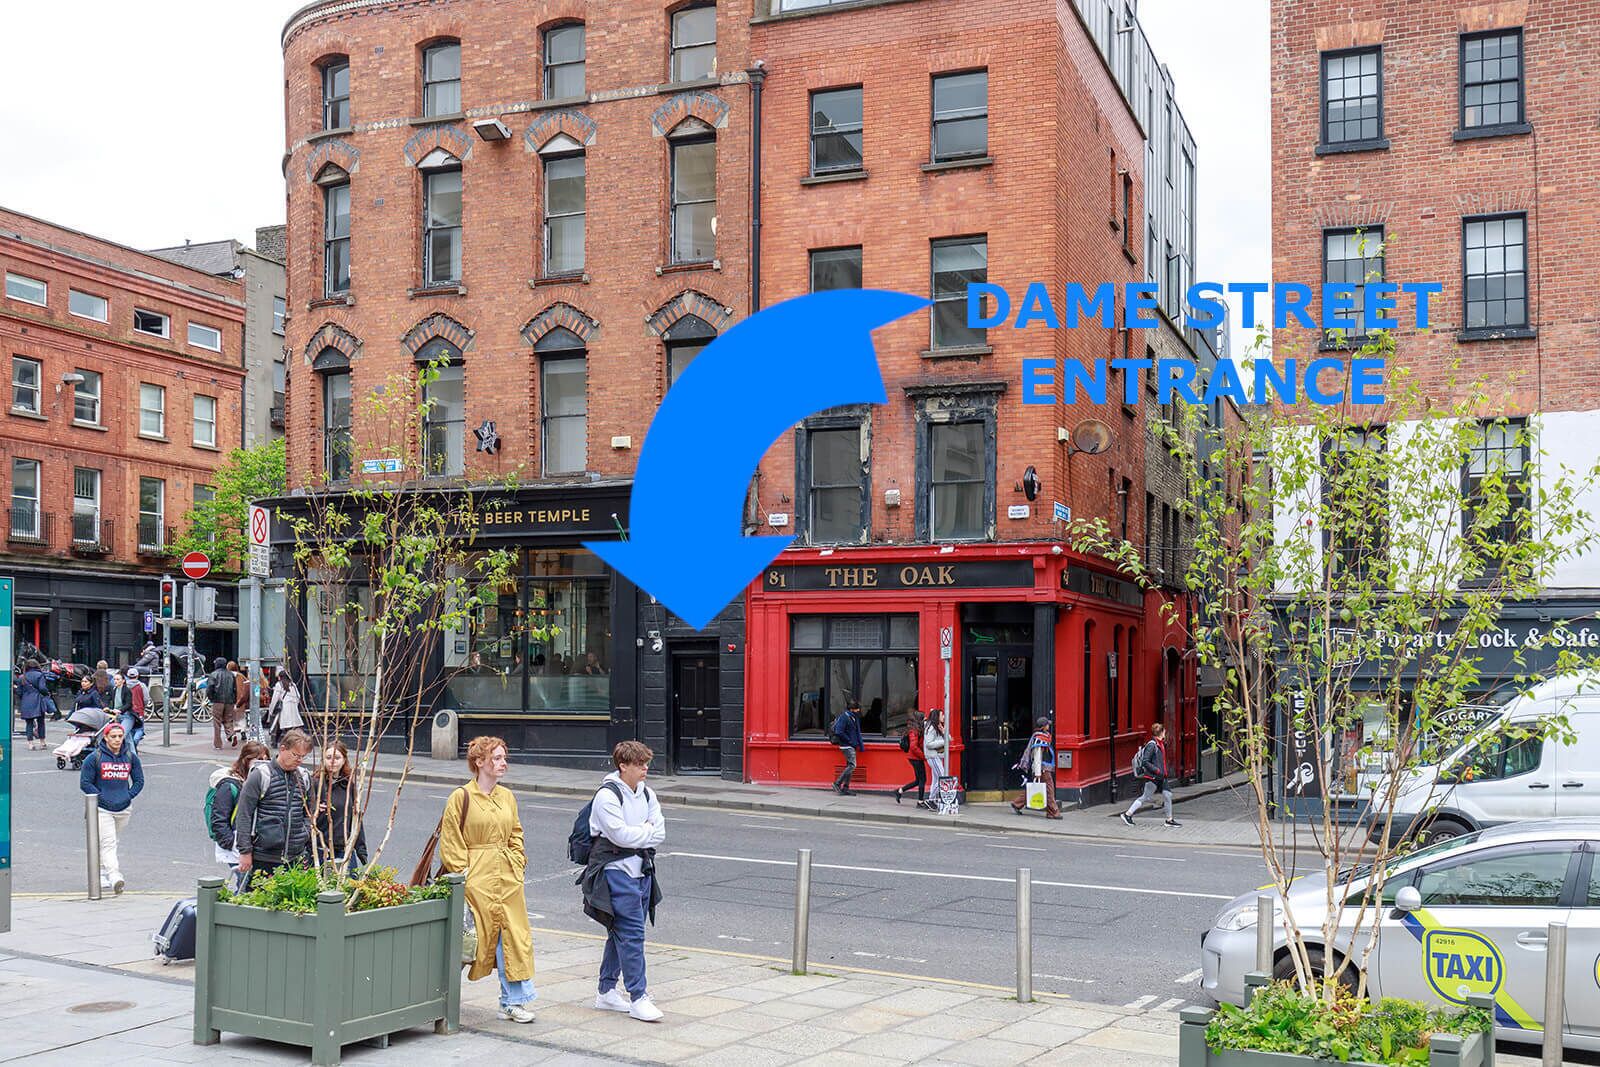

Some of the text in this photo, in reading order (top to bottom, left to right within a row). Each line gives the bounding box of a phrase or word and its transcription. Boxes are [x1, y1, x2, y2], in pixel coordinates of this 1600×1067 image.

[485, 512, 523, 524] BEER
[528, 509, 590, 522] TEMPLE
[769, 571, 786, 587] 81
[825, 566, 955, 587] THE OAK
[1525, 627, 1546, 647] &
[1552, 627, 1599, 647] Safe
[1440, 710, 1493, 724] FOGART
[1432, 952, 1493, 982] TAXI
